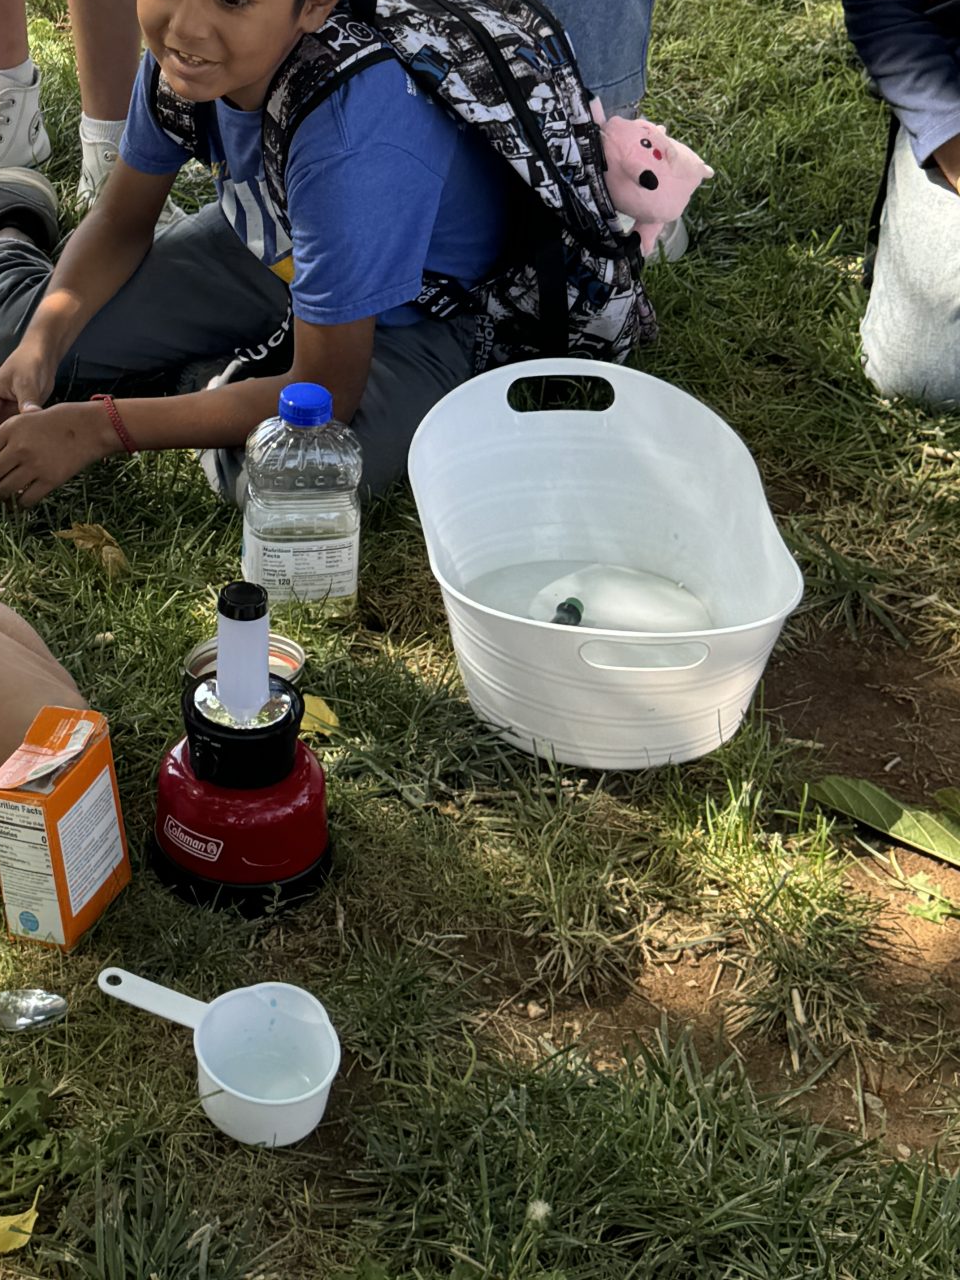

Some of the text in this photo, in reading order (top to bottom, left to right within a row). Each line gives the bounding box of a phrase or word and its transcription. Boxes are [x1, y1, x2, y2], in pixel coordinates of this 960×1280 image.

[278, 578, 291, 586] 120
[21, 805, 43, 816] Facts
[168, 819, 206, 852] Coleman
